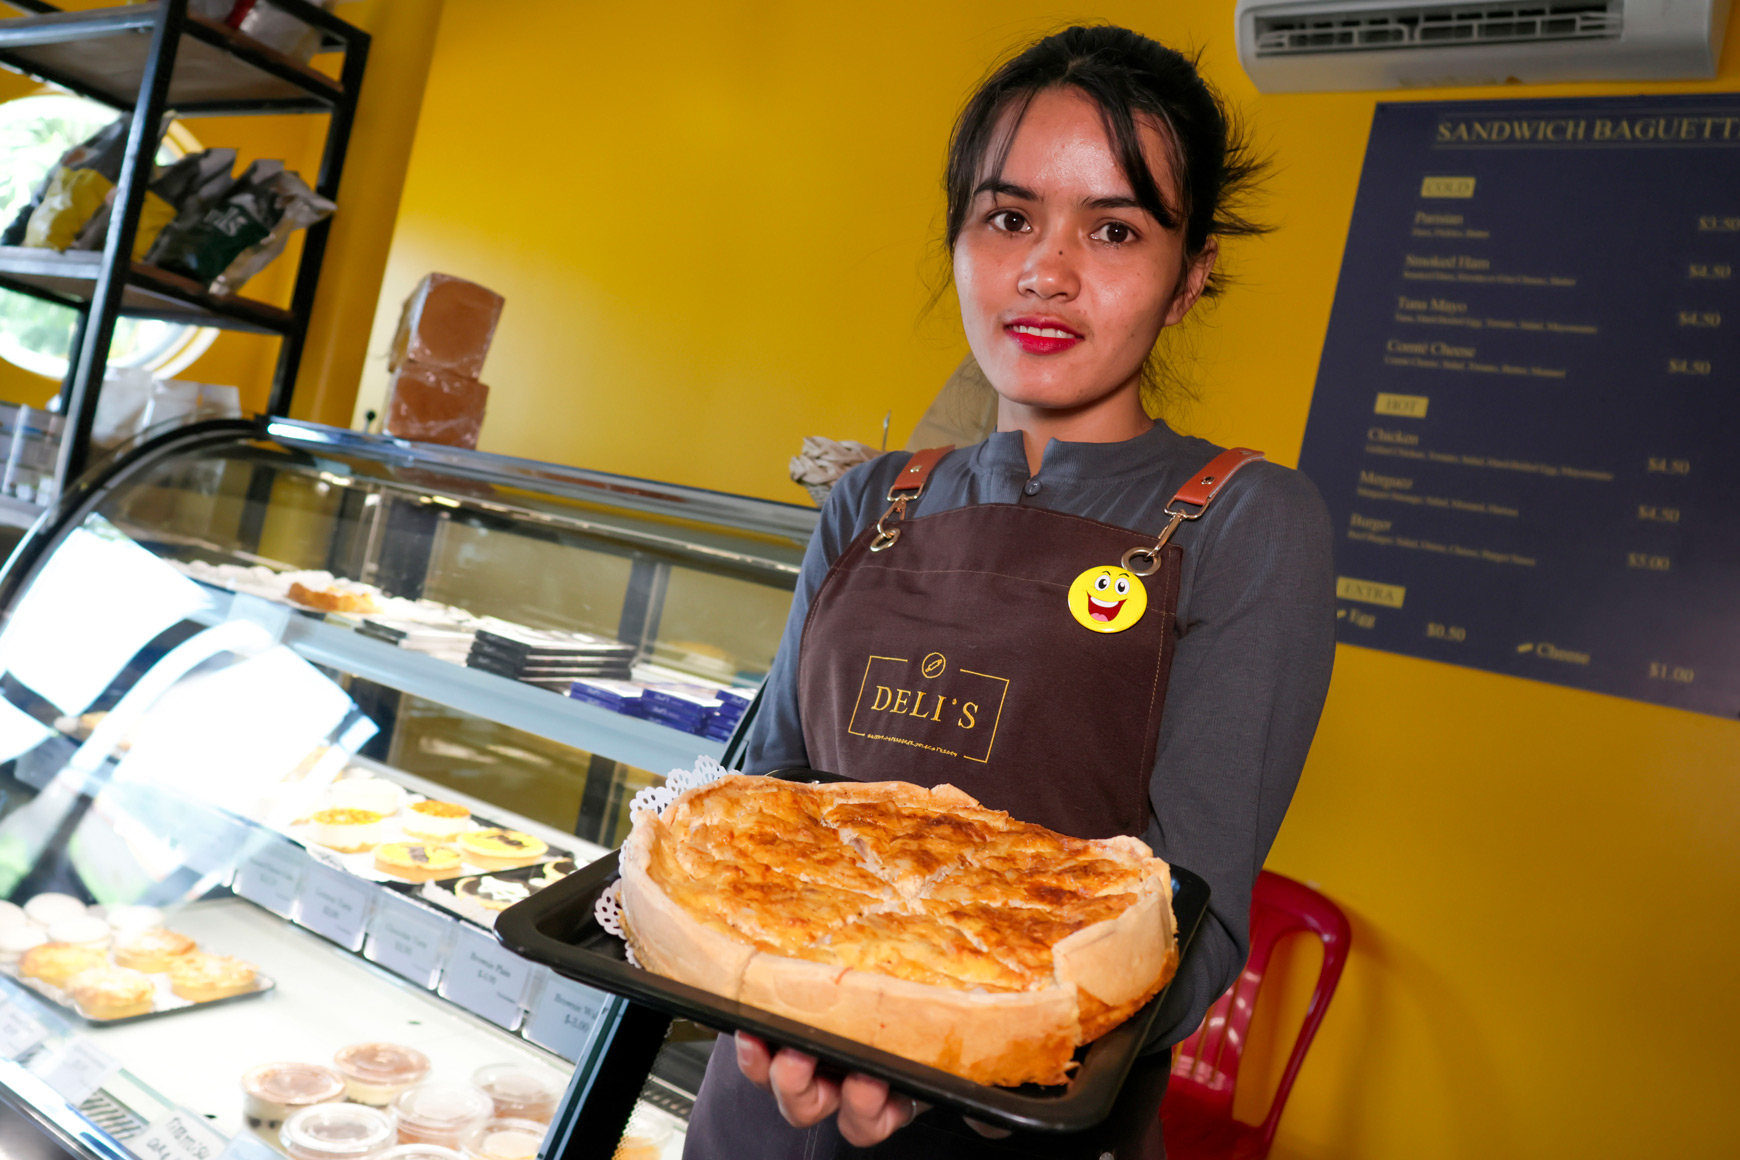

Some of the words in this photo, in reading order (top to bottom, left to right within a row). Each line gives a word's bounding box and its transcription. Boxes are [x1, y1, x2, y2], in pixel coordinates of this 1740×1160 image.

[1436, 119, 1587, 142] SANDWICH
[1593, 116, 1740, 141] BAGUETT
[1689, 264, 1731, 280] $4.50
[1679, 311, 1721, 328] $4.50
[1668, 358, 1711, 375] $4.50
[1367, 427, 1419, 446] Chicken
[1647, 457, 1690, 475] $4.50
[1350, 512, 1392, 532] Burger
[1637, 504, 1680, 523] $4.50
[1349, 608, 1376, 629] Egg
[1426, 622, 1466, 643] $0.50
[1536, 641, 1591, 666] Cheese
[1648, 661, 1695, 684] $1.00
[871, 685, 979, 730] DELI'S
